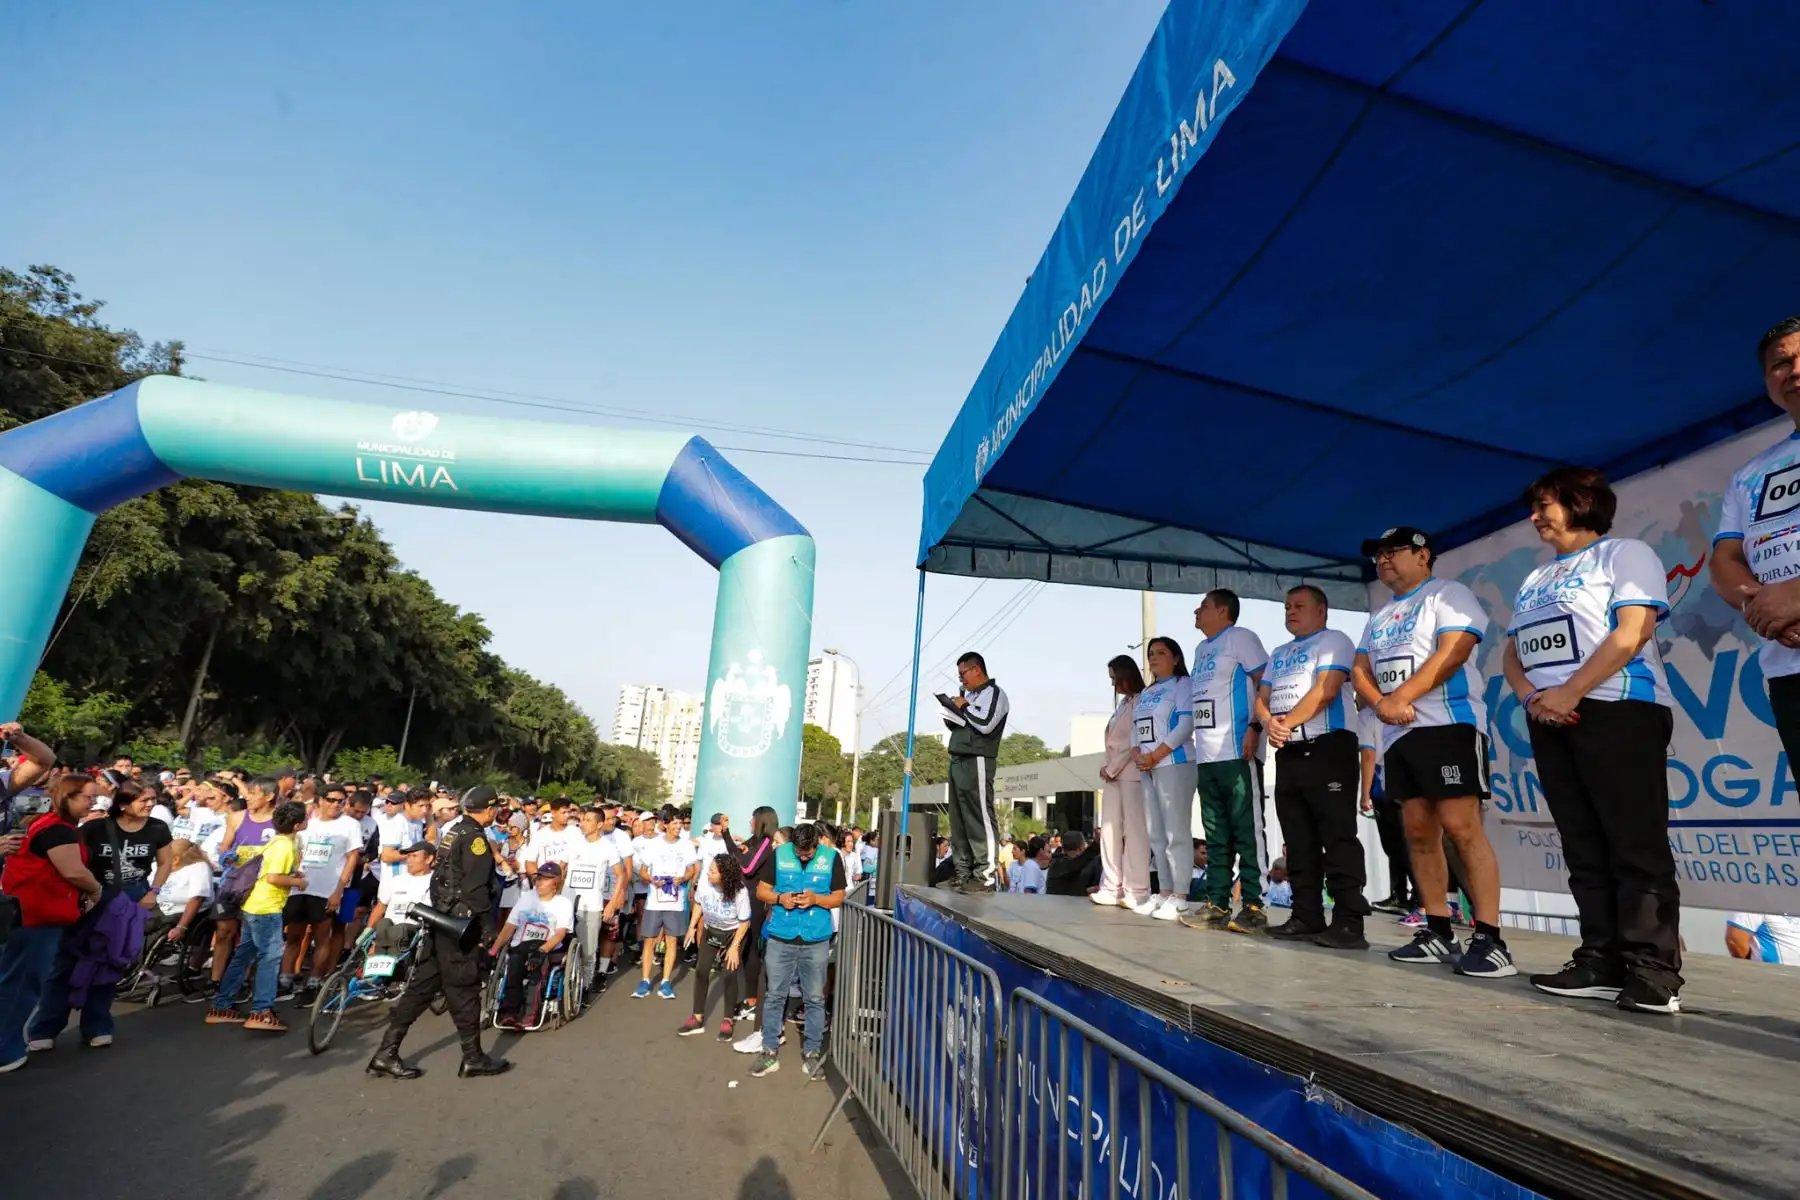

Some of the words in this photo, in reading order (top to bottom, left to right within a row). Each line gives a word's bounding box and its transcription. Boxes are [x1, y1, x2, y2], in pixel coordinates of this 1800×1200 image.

[991, 257, 1107, 456] MUNICIPALIDAD
[1114, 186, 1146, 265] DE
[1156, 58, 1236, 198] LIMA
[356, 457, 459, 490] LIMA
[1521, 633, 1567, 656] 0009
[1696, 833, 1750, 855] DEL
[1674, 859, 1798, 887] TIDROGAS
[367, 960, 392, 970] 3877
